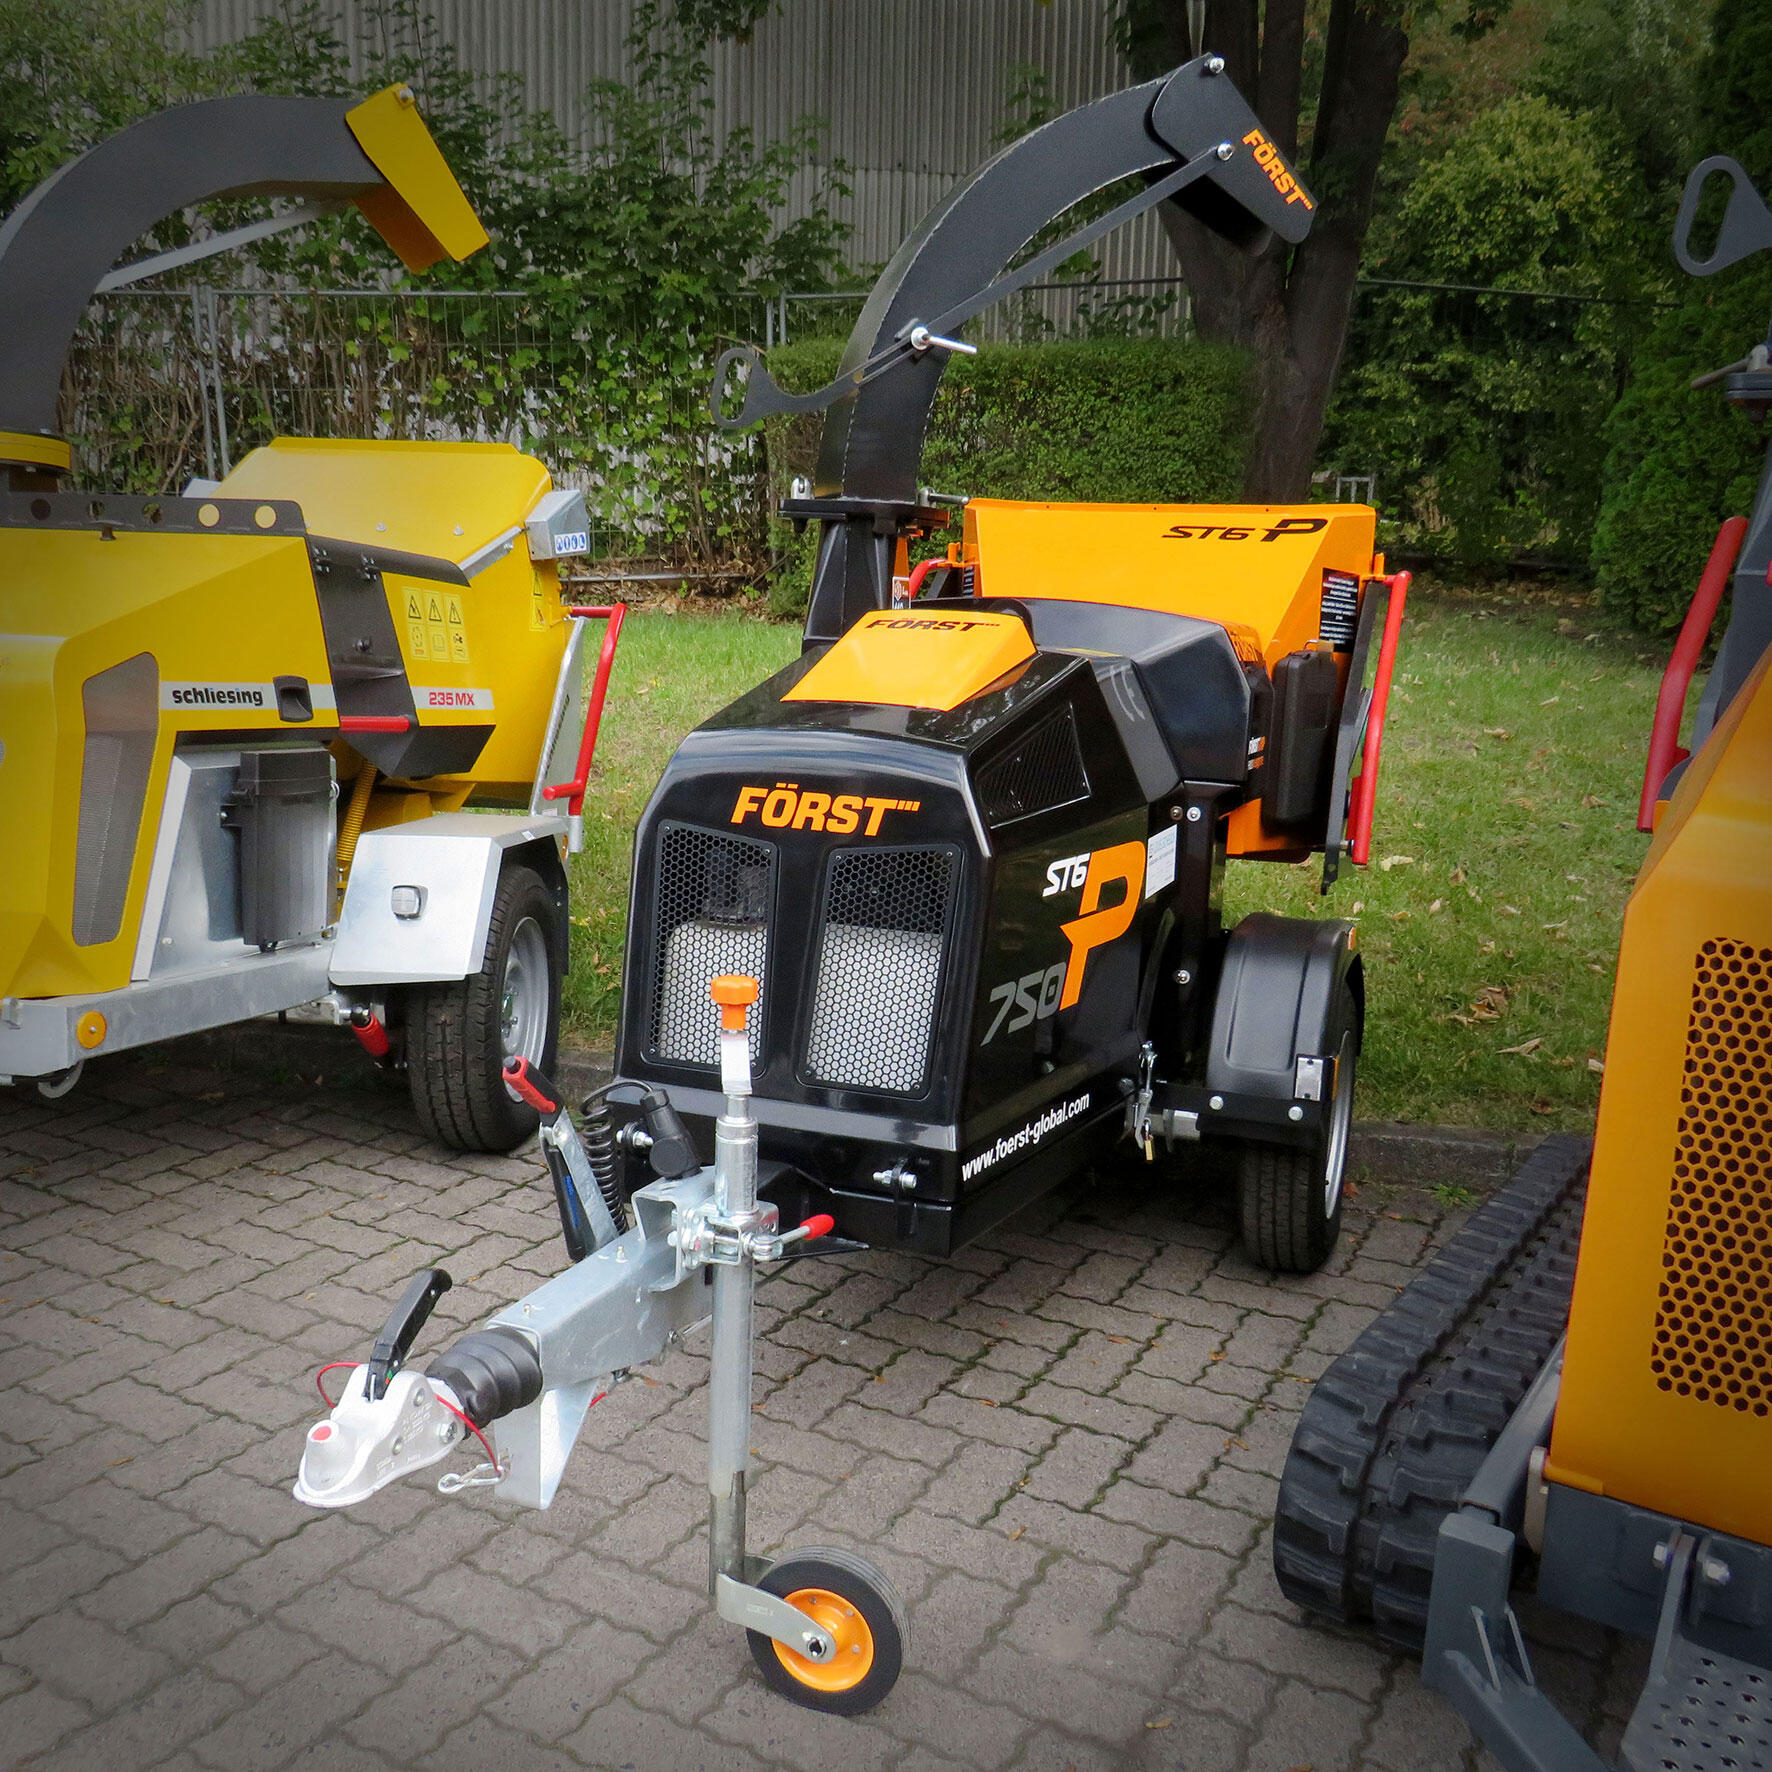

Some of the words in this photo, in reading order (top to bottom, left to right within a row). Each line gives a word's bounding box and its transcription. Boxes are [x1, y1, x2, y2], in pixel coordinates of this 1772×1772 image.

[1241, 129, 1313, 211] FÖRST
[865, 617, 1001, 632] FÖRST
[172, 687, 264, 706] schliesing
[730, 782, 921, 837] FÖRST
[980, 961, 1067, 1047] 750
[961, 1093, 1090, 1182] www.foerst-global.com
